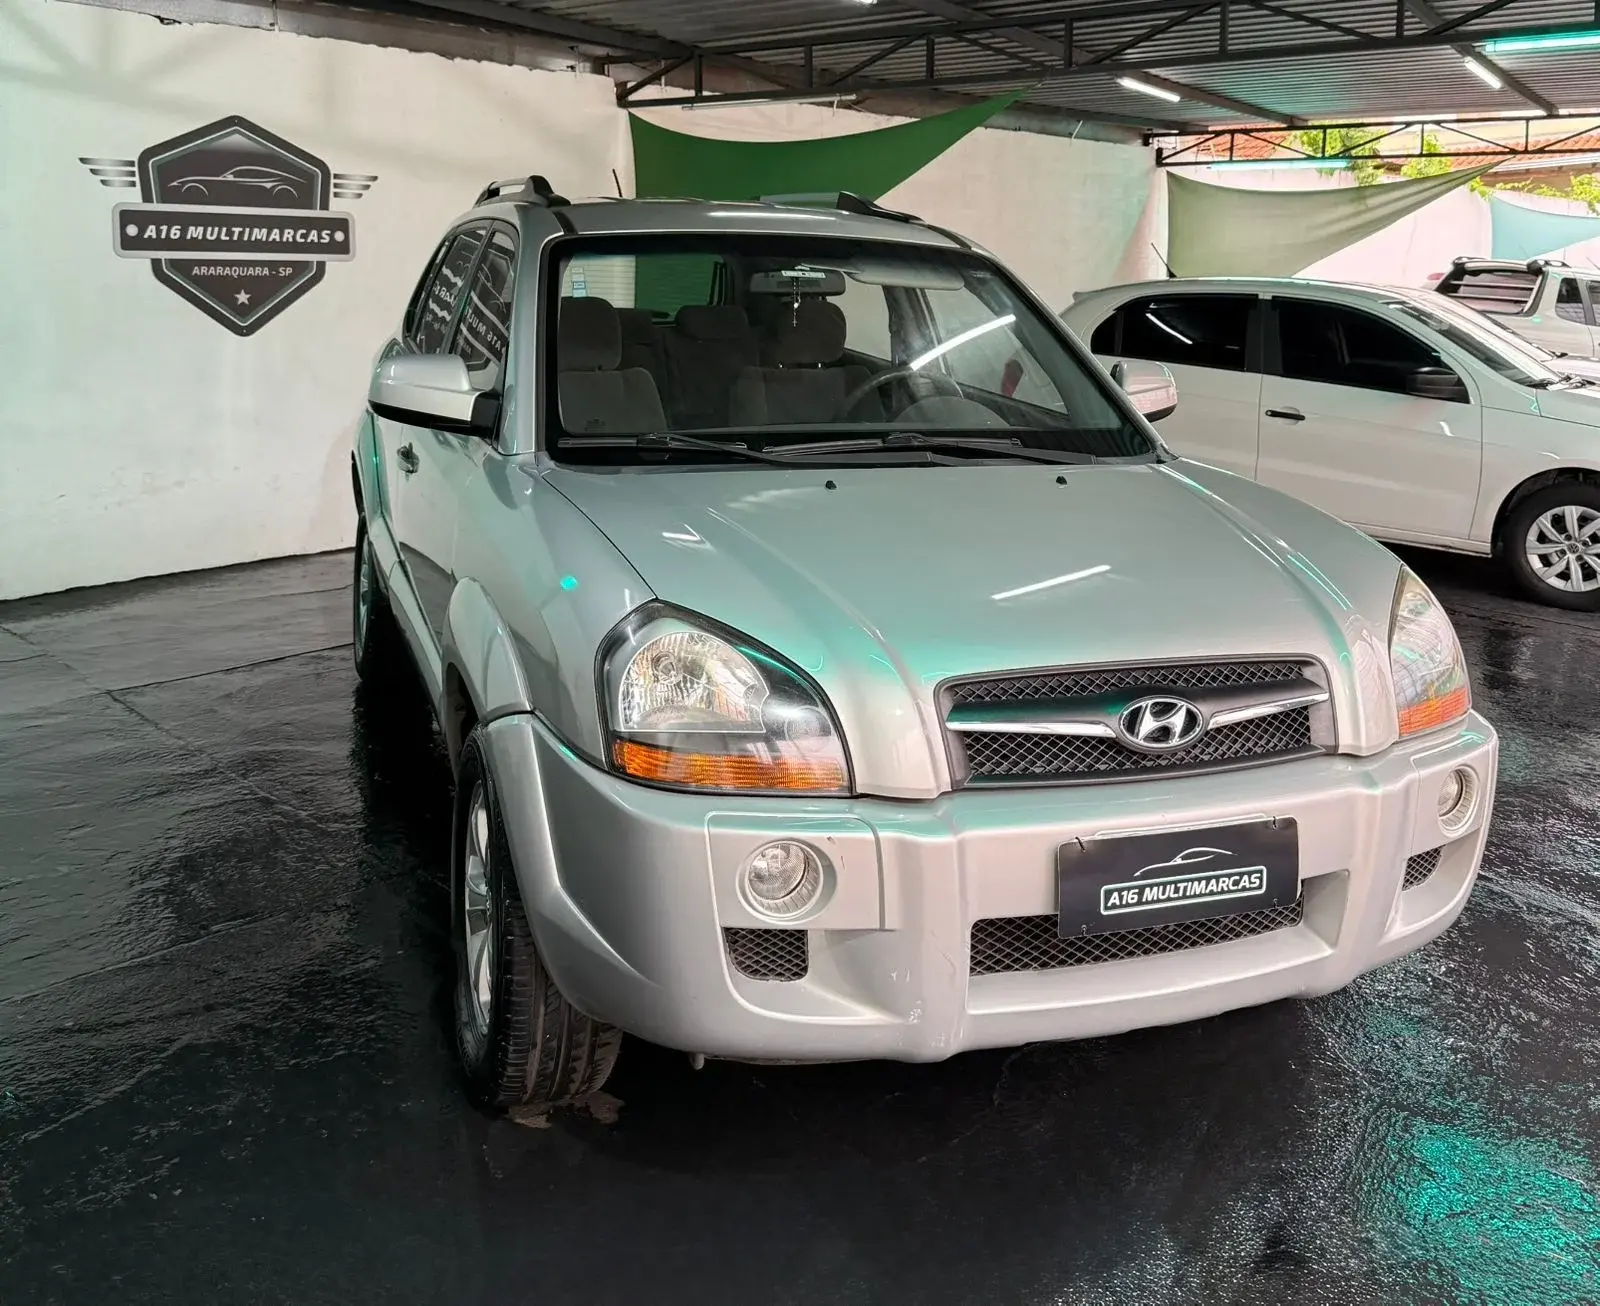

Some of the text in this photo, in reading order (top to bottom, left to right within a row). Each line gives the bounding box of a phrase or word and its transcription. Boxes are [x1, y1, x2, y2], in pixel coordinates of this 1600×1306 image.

[143, 225, 332, 243] A16 MULTIMARCAS
[192, 266, 269, 278] ARARAQUARA
[278, 267, 293, 277] SP
[1107, 872, 1261, 907] A16 MULTIMARCAS
